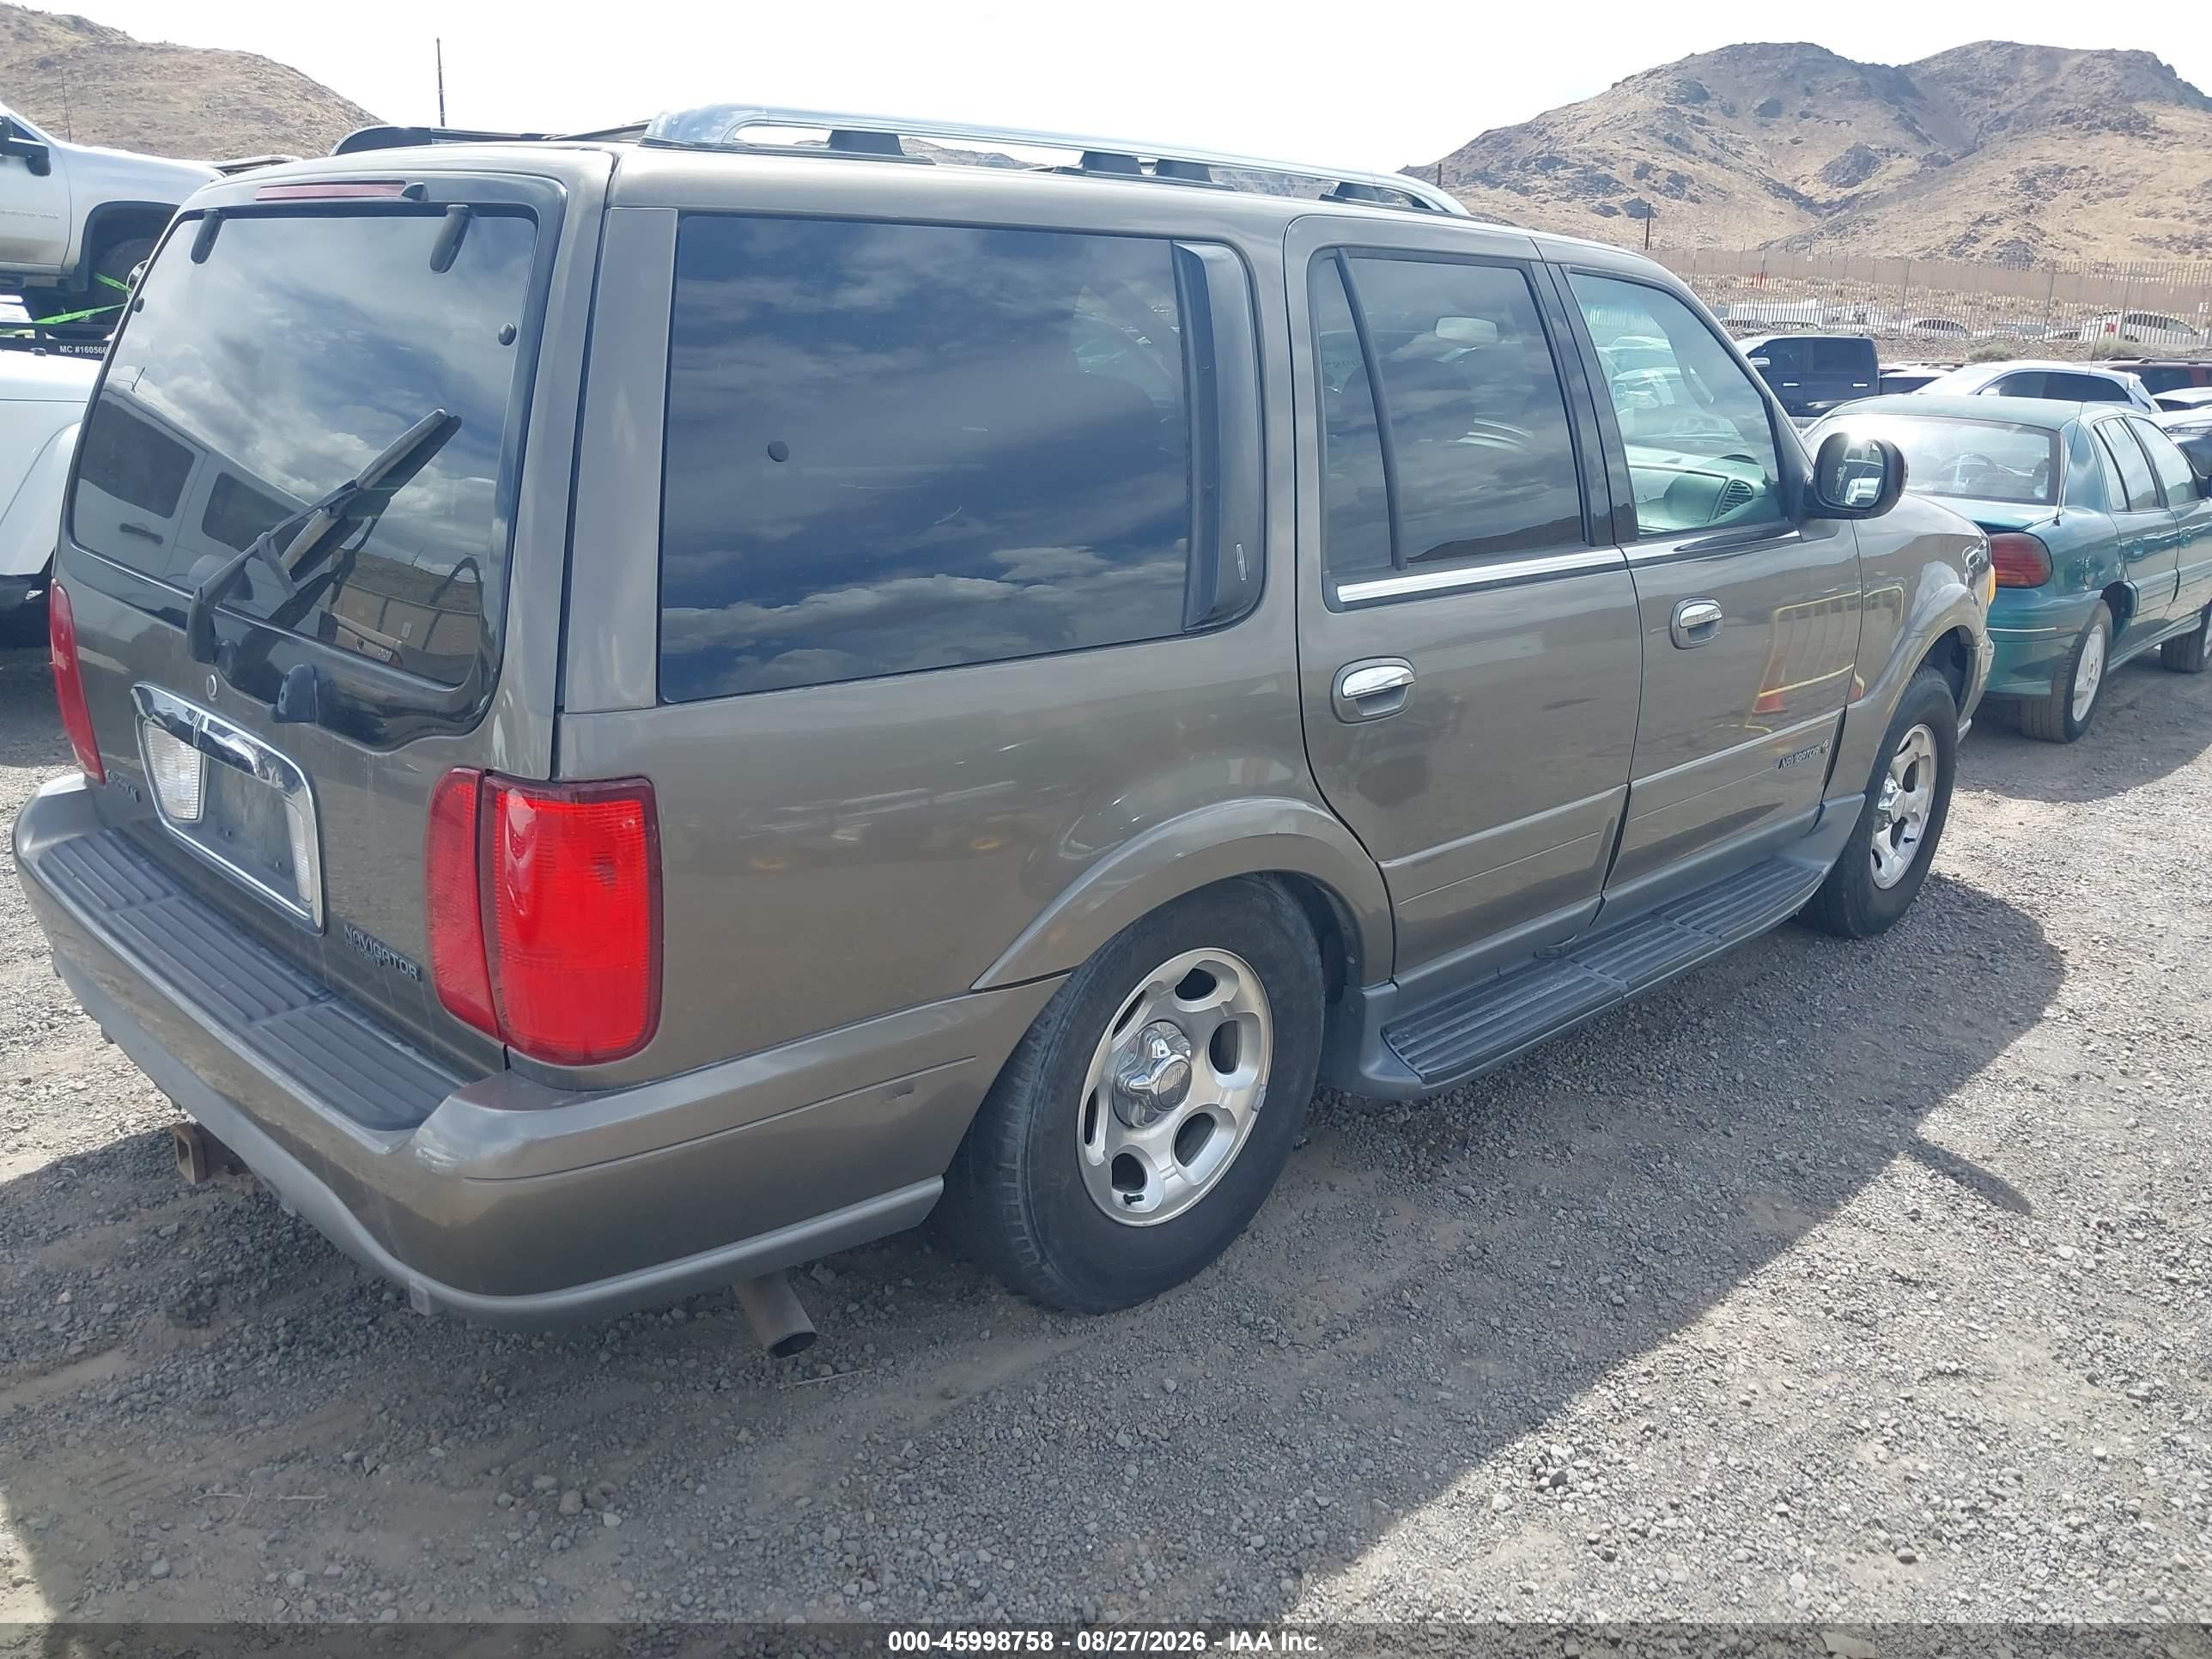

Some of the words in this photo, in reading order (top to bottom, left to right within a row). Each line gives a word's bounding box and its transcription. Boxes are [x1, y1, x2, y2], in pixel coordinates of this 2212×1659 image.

[59, 345, 73, 354] MC
[1778, 745, 1820, 769] NAVIGATOR
[343, 924, 418, 981] NAVIGATOR
